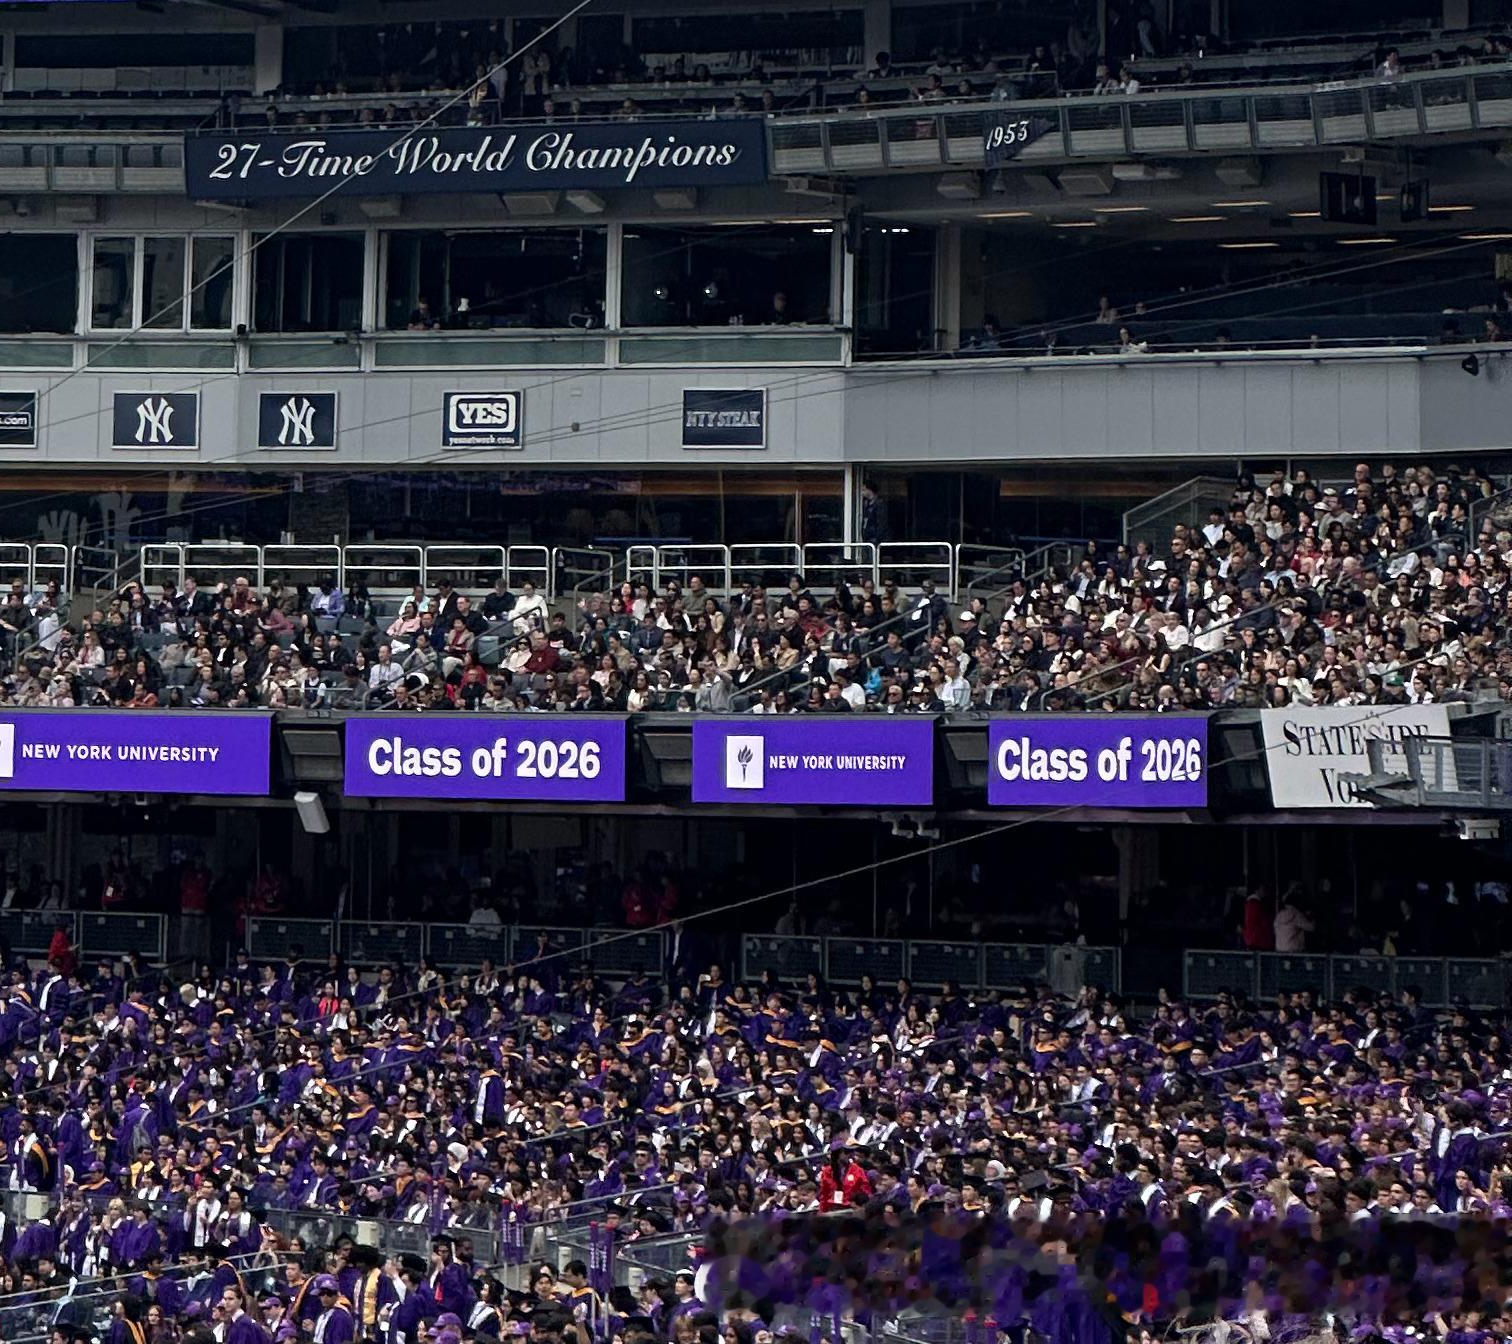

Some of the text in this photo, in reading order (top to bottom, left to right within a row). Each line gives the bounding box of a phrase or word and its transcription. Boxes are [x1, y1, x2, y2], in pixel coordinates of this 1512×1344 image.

[986, 120, 1029, 150] 1953
[209, 131, 740, 183] 27-Time World Champions
[458, 402, 508, 425] YES
[22, 744, 219, 762] NEW YORK UNIVERSITY
[368, 736, 600, 779] Class of 2026
[769, 755, 906, 770] NEW YORK UNIVERSITY
[997, 736, 1201, 781] Class of 2026
